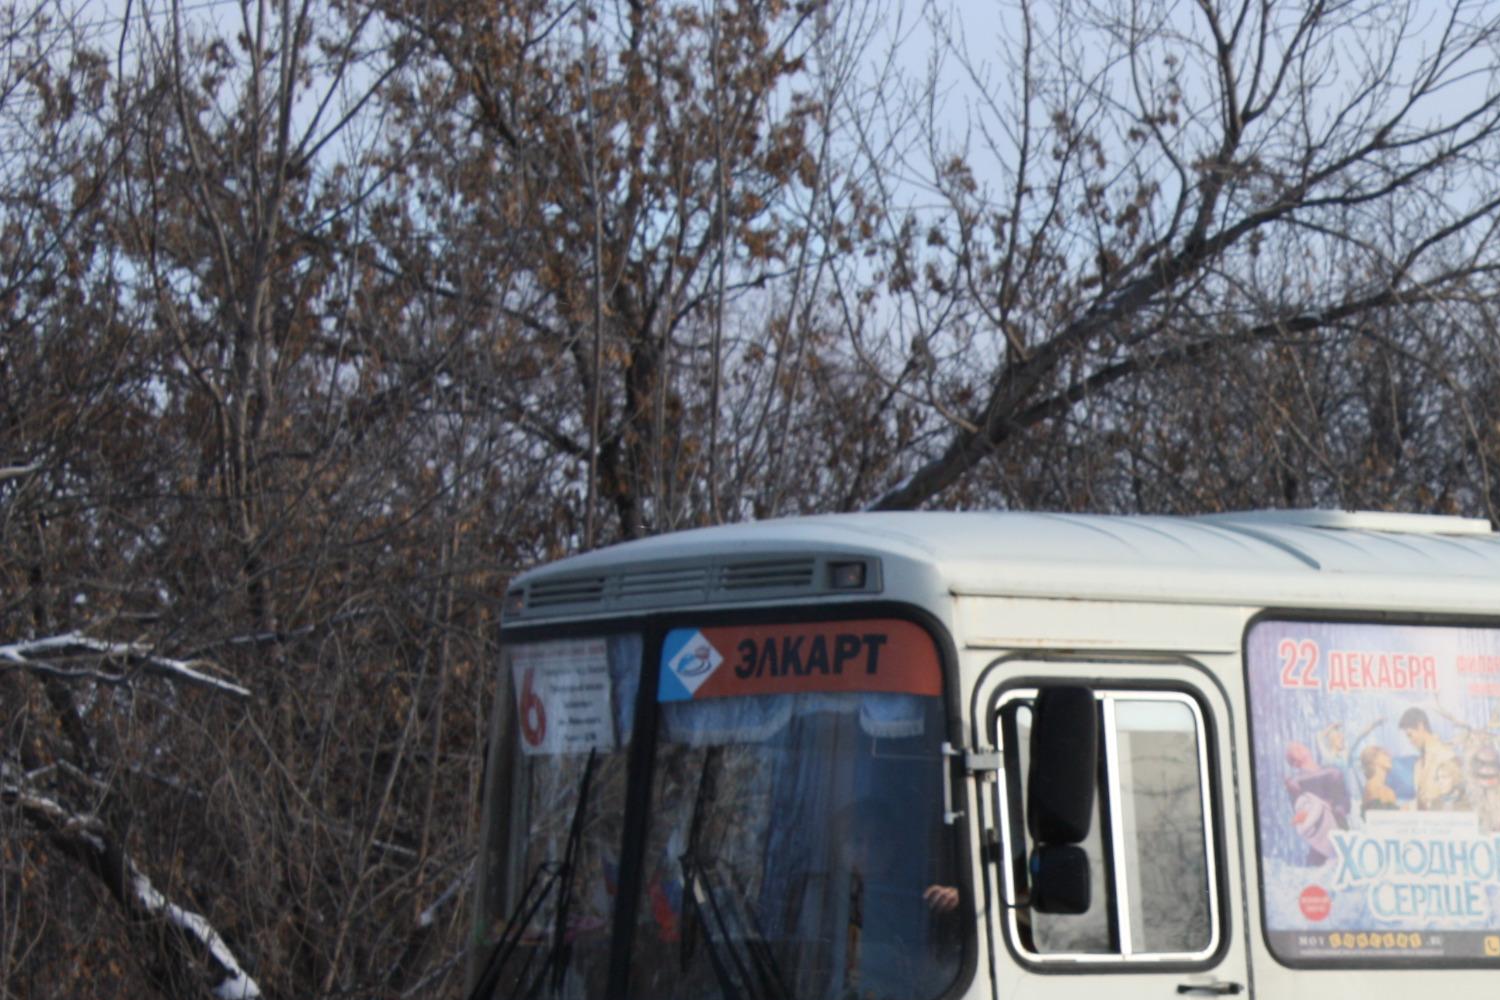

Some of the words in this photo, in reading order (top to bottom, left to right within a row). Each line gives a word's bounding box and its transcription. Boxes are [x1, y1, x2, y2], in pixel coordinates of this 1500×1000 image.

[734, 633, 887, 680] ЭЛКАРТ
[1279, 639, 1320, 688] 22
[1328, 651, 1438, 691] ДЕКАБРЯ
[520, 667, 546, 747] 6
[1371, 881, 1486, 918] СЕРДЦЕ
